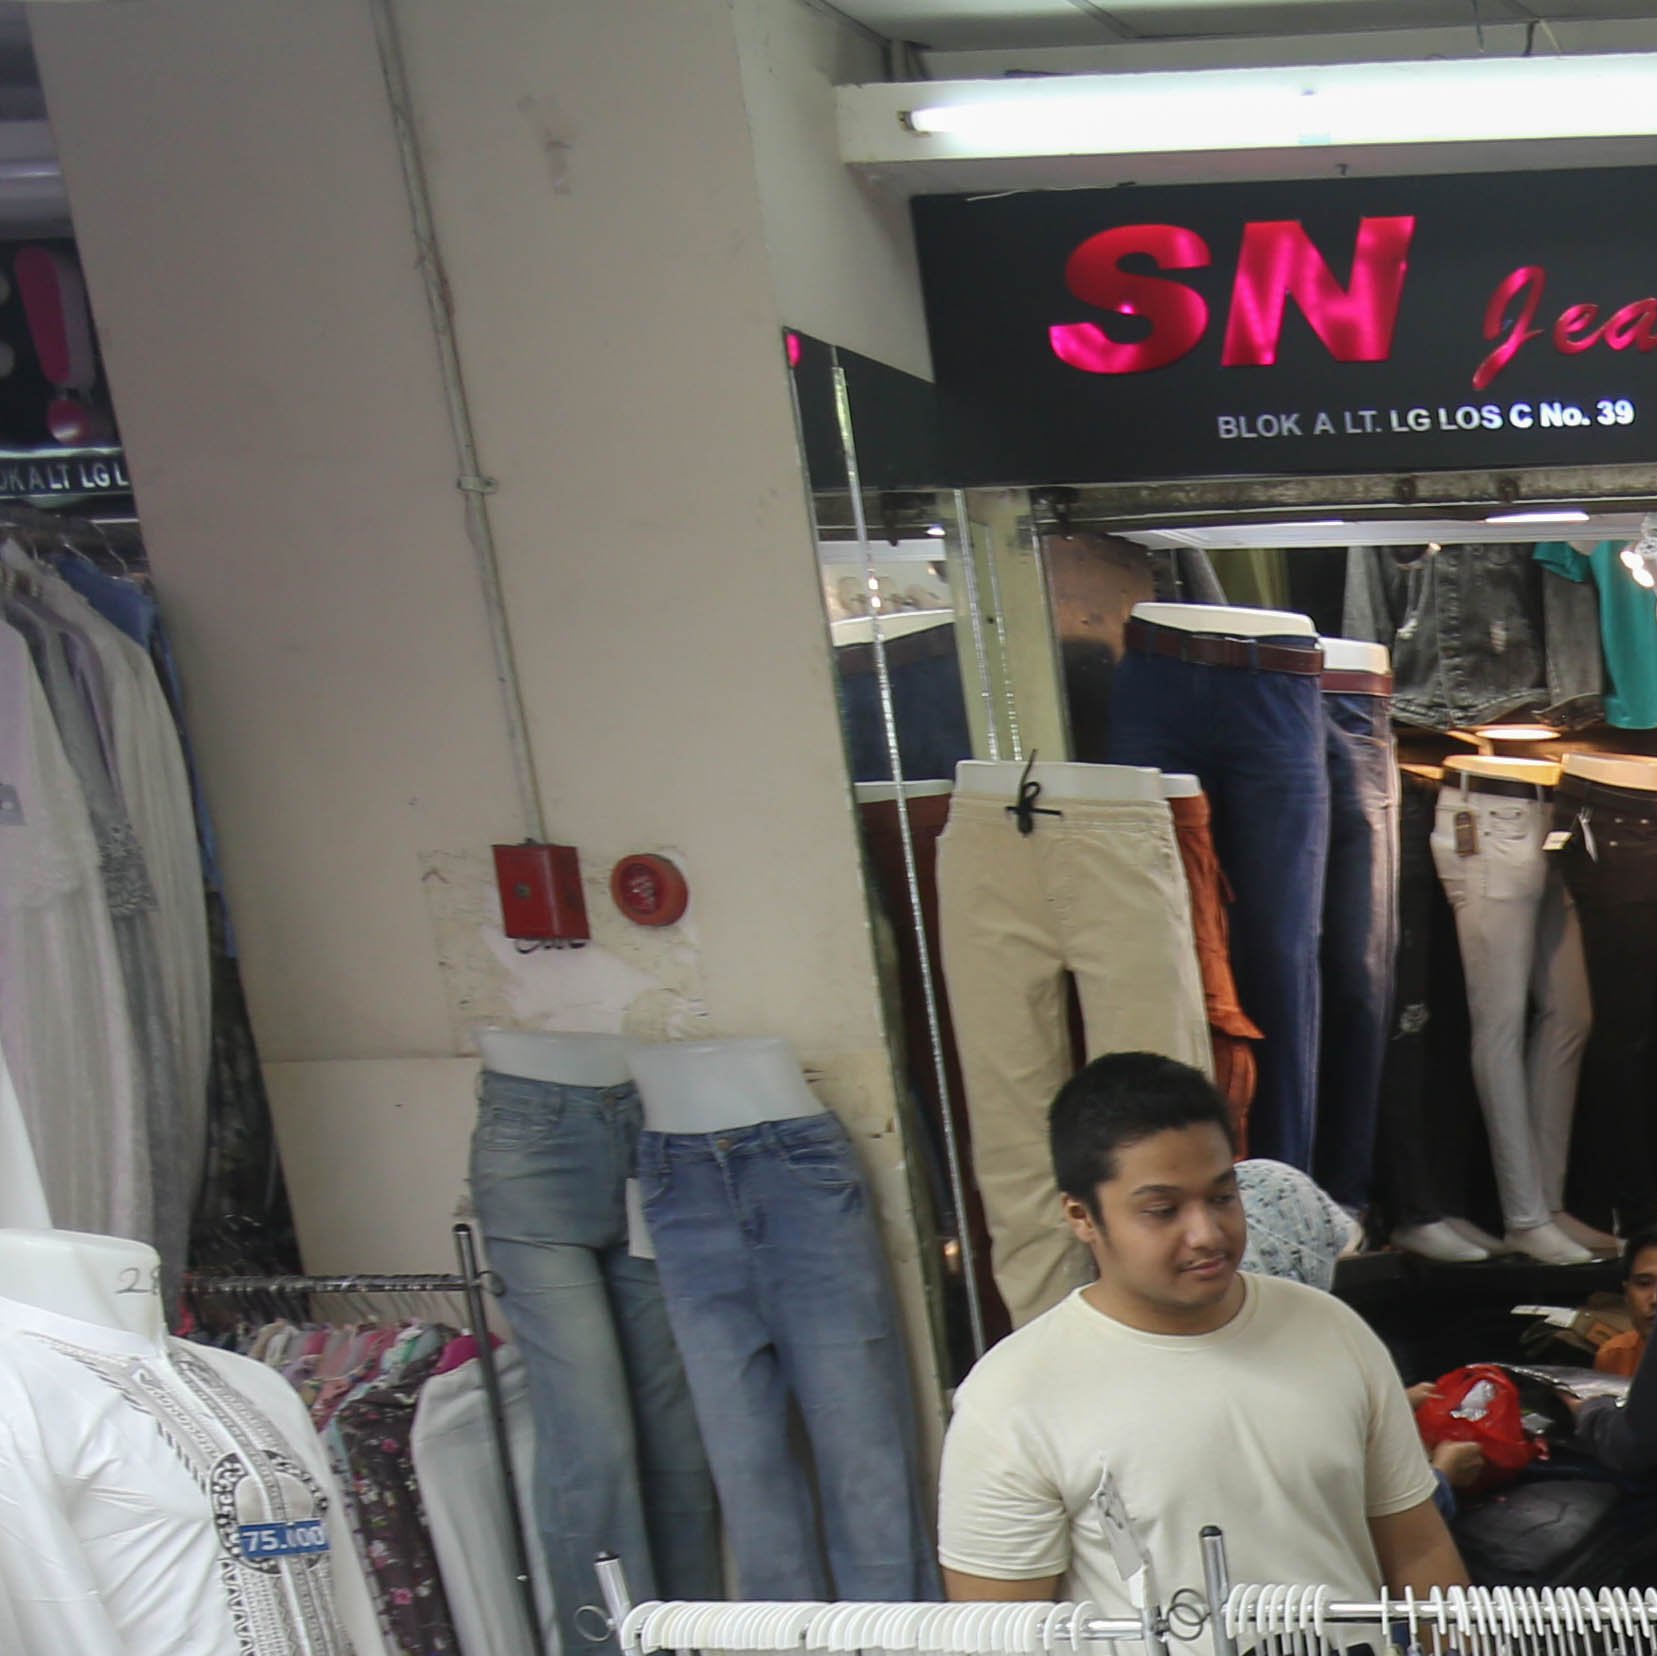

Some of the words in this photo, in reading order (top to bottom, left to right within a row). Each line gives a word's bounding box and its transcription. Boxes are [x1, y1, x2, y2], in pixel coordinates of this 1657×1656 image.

[1049, 215, 1415, 375] SN
[1217, 412, 1302, 440] BLOK
[1313, 411, 1335, 435] A
[1344, 409, 1383, 434] LT.
[1390, 407, 1432, 433] LG
[1438, 404, 1503, 431] LOS
[1509, 402, 1534, 429] C
[1540, 401, 1591, 428] No.
[1595, 399, 1636, 426] 39
[48, 464, 70, 489] LT
[80, 462, 112, 488] LG
